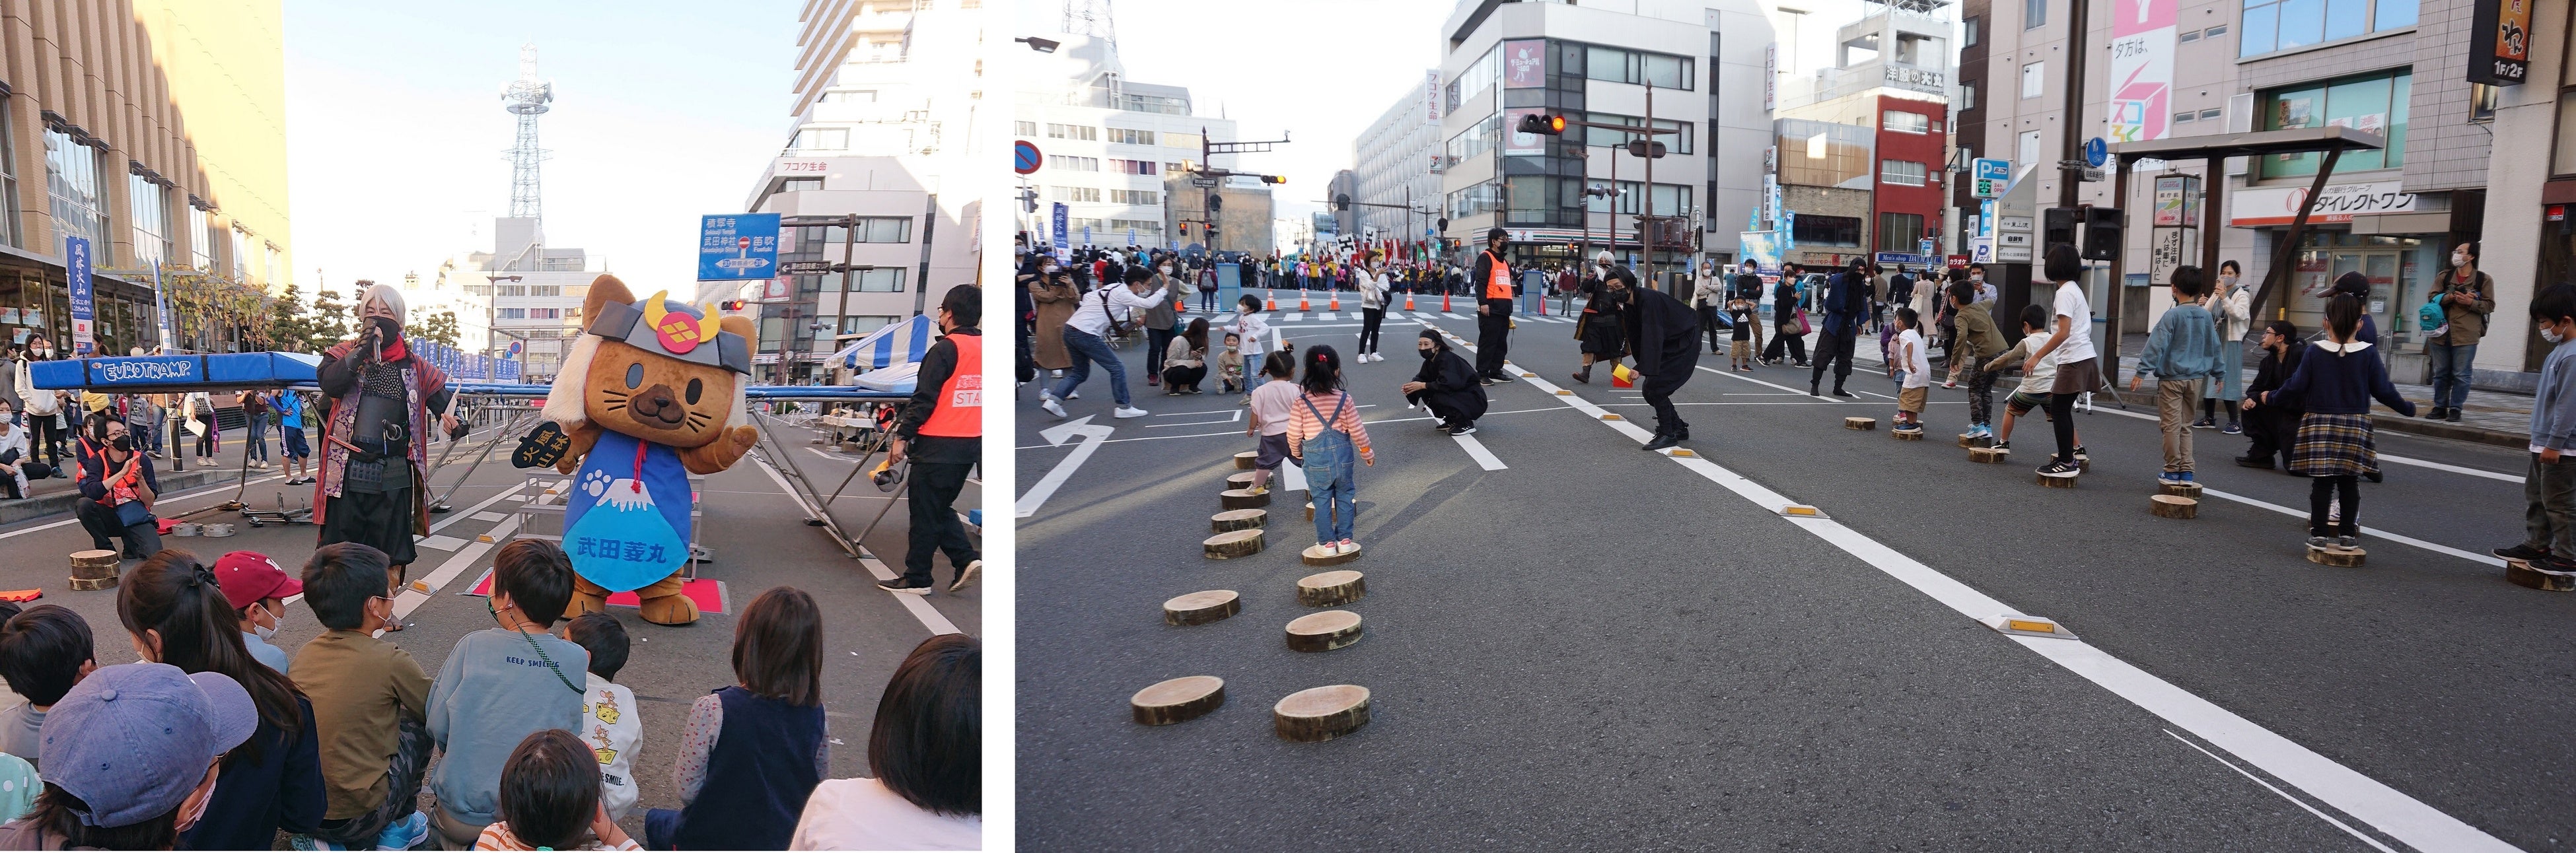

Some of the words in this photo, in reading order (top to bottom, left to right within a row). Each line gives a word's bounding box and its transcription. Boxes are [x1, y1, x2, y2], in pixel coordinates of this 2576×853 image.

[2116, 38, 2147, 59] 夕方は、
[1886, 65, 1943, 87] 洋服の大丸
[2495, 61, 2523, 78] 1F/2F
[1429, 74, 1437, 119] フコク生命
[784, 162, 827, 171] フコク生命
[1981, 162, 1992, 178] P
[1978, 180, 1991, 195] 空
[2322, 185, 2372, 195] ルガ銀行グループ
[2312, 193, 2414, 212] ダイレクトワン
[706, 217, 736, 228] 積翠寺
[704, 236, 736, 246] 武田神社
[753, 236, 774, 246] 笛吹
[2170, 231, 2178, 264] まず注意
[74, 244, 86, 296] 風林火山
[104, 361, 191, 381] EUROTRAMP
[577, 537, 666, 563] 武田菱丸
[506, 656, 524, 665] KEEP
[605, 774, 624, 786] SMILE.
